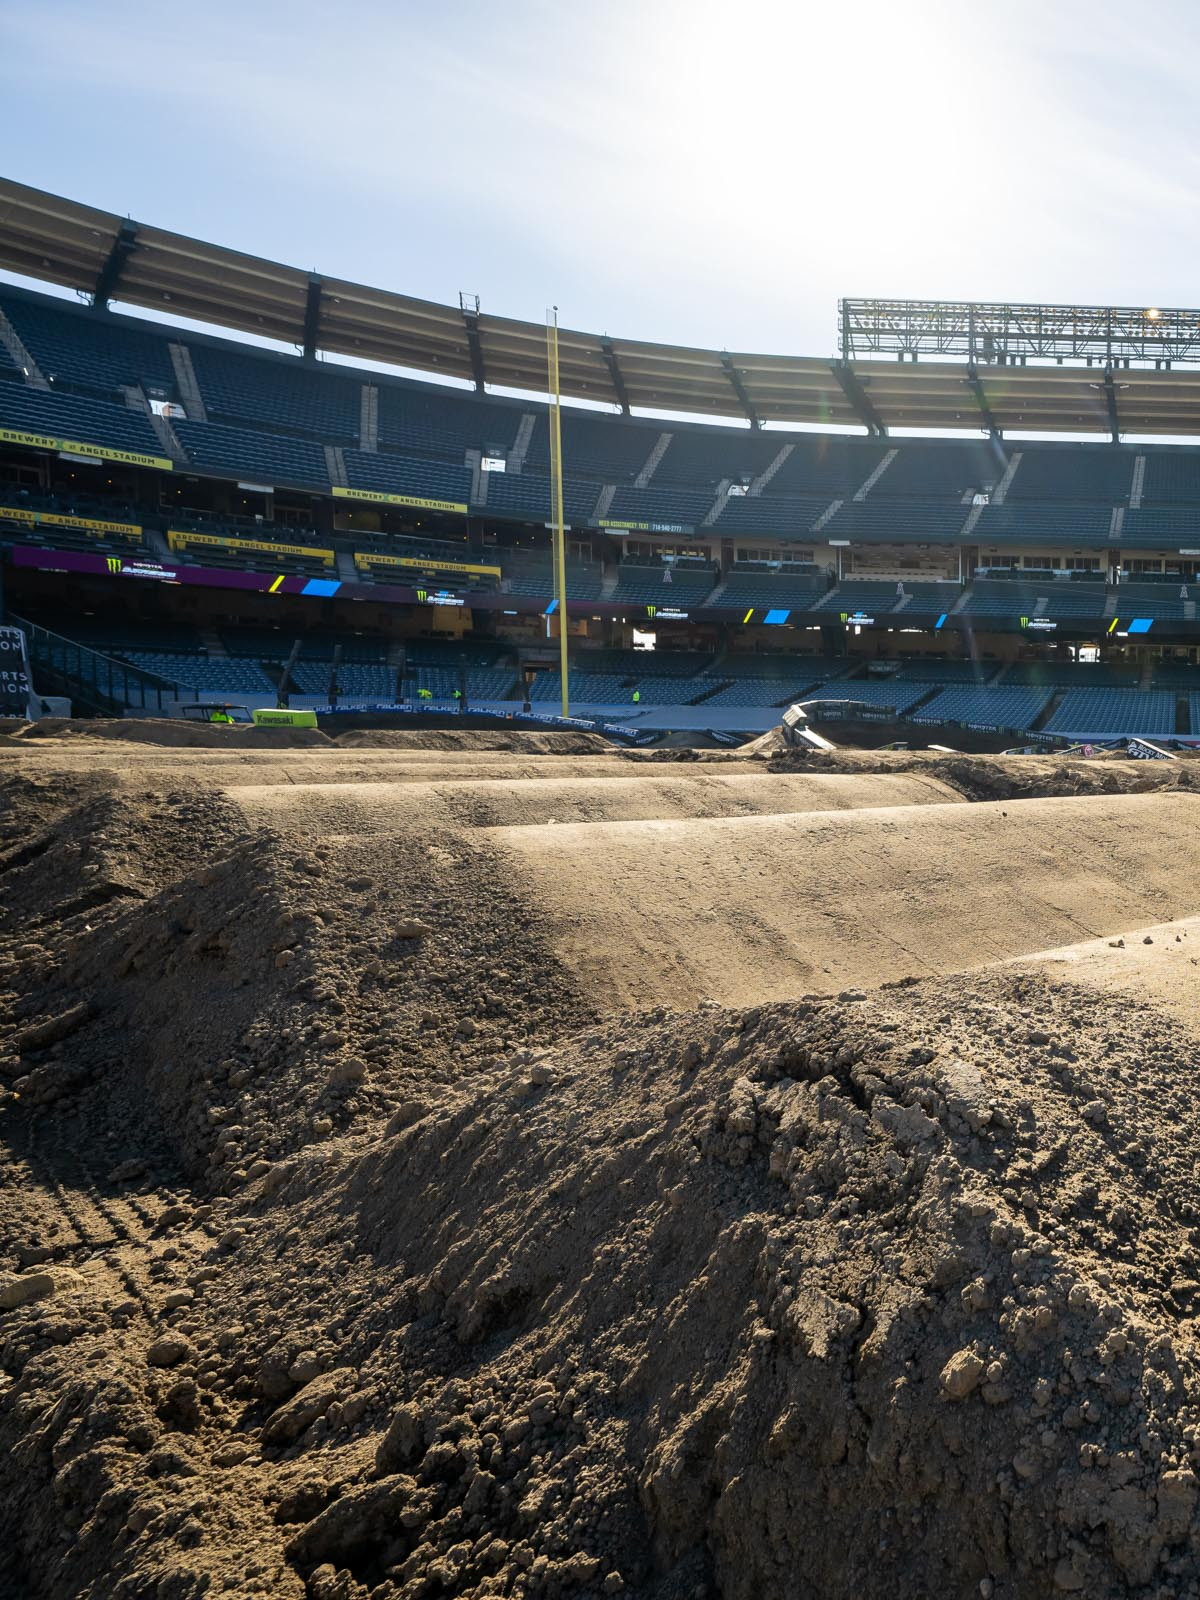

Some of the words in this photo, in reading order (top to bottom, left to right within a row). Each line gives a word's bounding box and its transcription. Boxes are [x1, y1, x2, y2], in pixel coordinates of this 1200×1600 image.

[3, 432, 55, 447] BREWERY
[80, 446, 110, 457] ANGEL
[113, 452, 155, 465] STADIUM
[347, 490, 383, 500] BREWERY
[425, 501, 455, 510] STADIUM
[58, 517, 89, 527] ANGEL
[92, 522, 134, 533] STADIUM
[175, 533, 219, 544] BREWERY
[360, 555, 396, 563] BREWERY
[257, 714, 293, 725] Kawasaki
